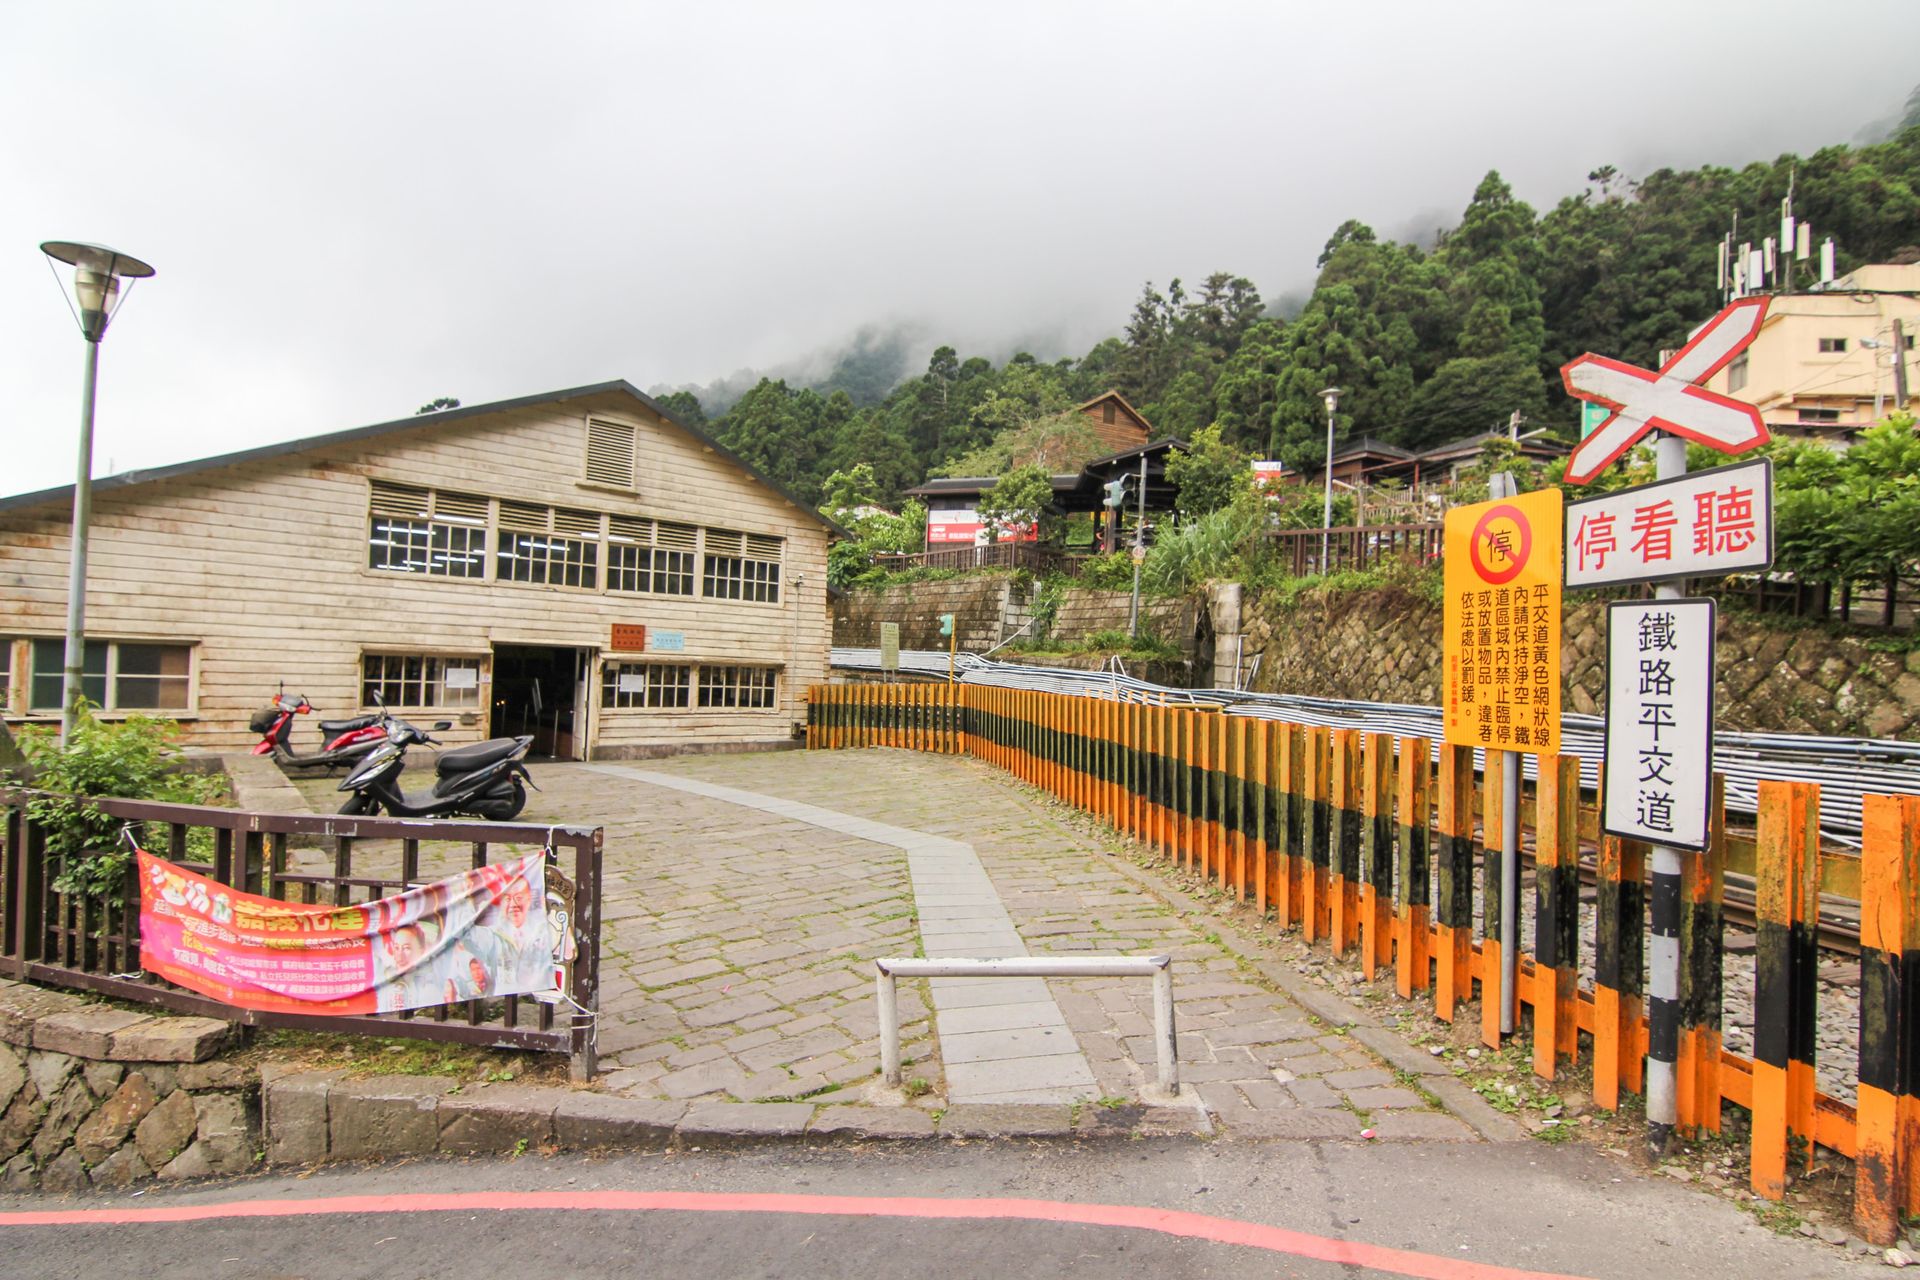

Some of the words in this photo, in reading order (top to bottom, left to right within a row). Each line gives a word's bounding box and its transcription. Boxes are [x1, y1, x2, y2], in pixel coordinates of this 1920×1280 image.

[1487, 529, 1512, 563] 停
[1573, 485, 1756, 571] 停看聽
[1495, 588, 1511, 744] 道區域內禁止臨停
[1532, 583, 1550, 747] 平交道黃色網狀線
[1637, 611, 1677, 833] 鐵路平交道
